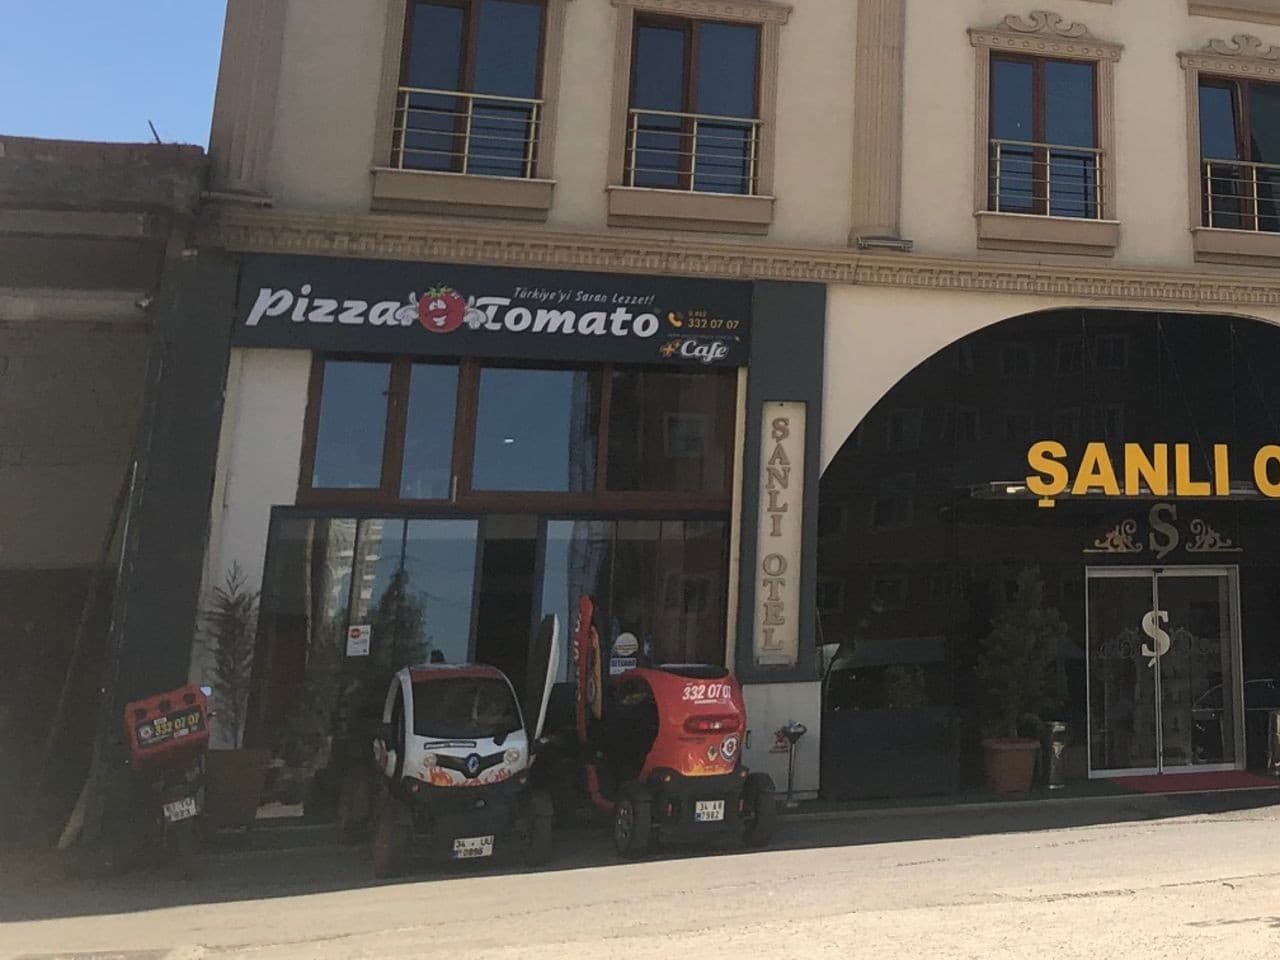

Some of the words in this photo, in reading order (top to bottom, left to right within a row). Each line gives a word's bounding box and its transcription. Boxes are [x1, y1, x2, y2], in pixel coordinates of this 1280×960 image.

[575, 290, 607, 302] Saran
[476, 296, 660, 338] Tomato
[688, 318, 707, 328] 332
[710, 319, 723, 329] 07
[726, 320, 739, 330] 07
[1025, 441, 1230, 508] ŞANLI
[762, 553, 788, 651] OTEL
[682, 685, 706, 700] 332
[708, 684, 722, 698] 07
